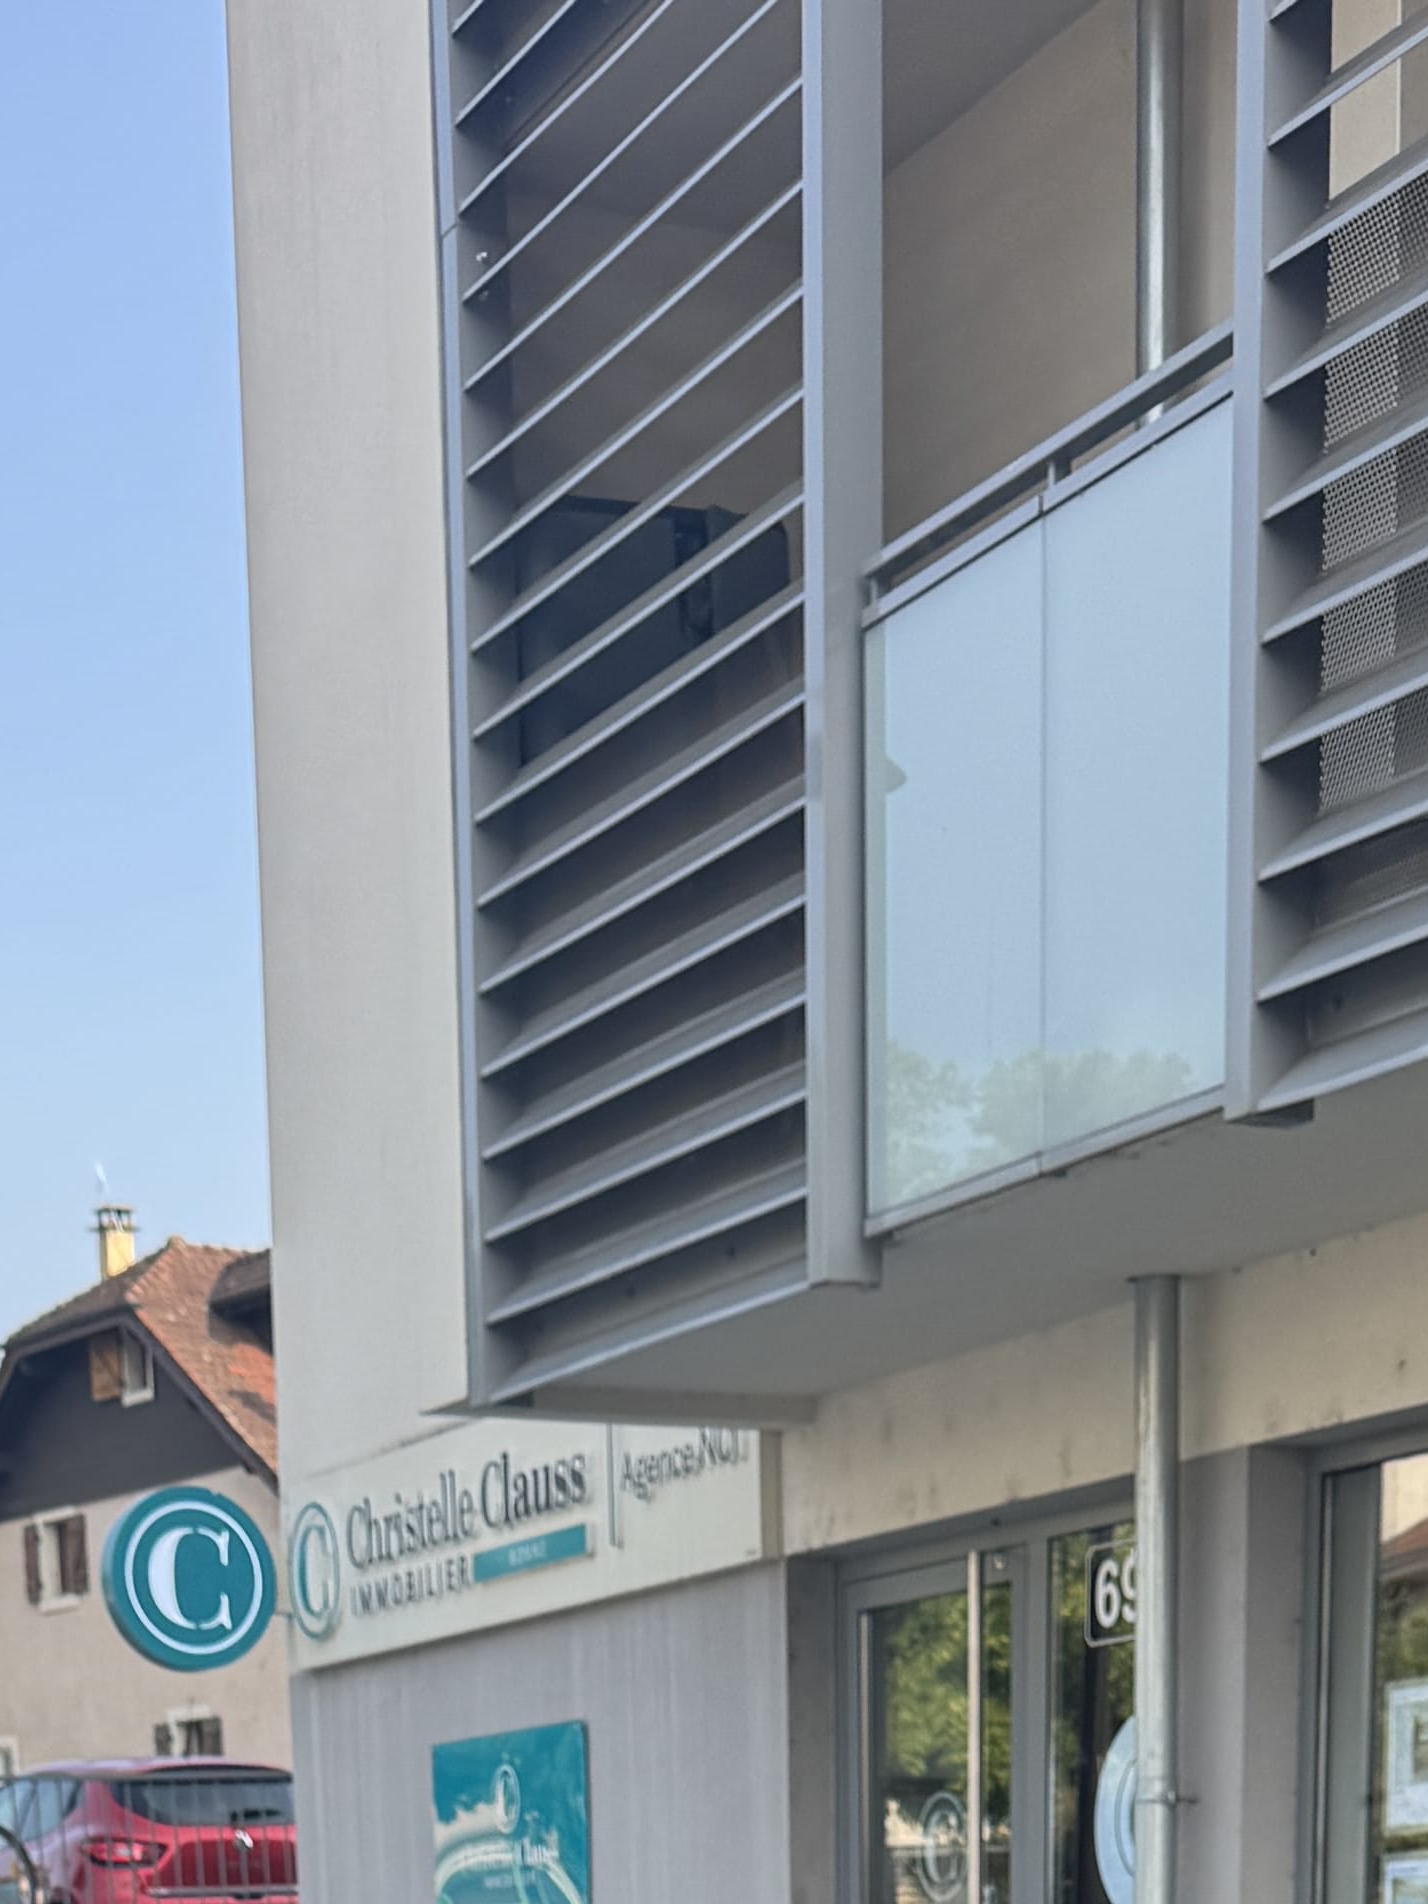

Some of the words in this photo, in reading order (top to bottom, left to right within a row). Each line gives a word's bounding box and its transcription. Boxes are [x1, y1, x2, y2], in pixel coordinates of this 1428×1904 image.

[345, 1469, 474, 1570] Christelle
[481, 1451, 586, 1529] Clauss
[148, 1527, 232, 1630] C
[350, 1555, 471, 1616] IMMOBILIER
